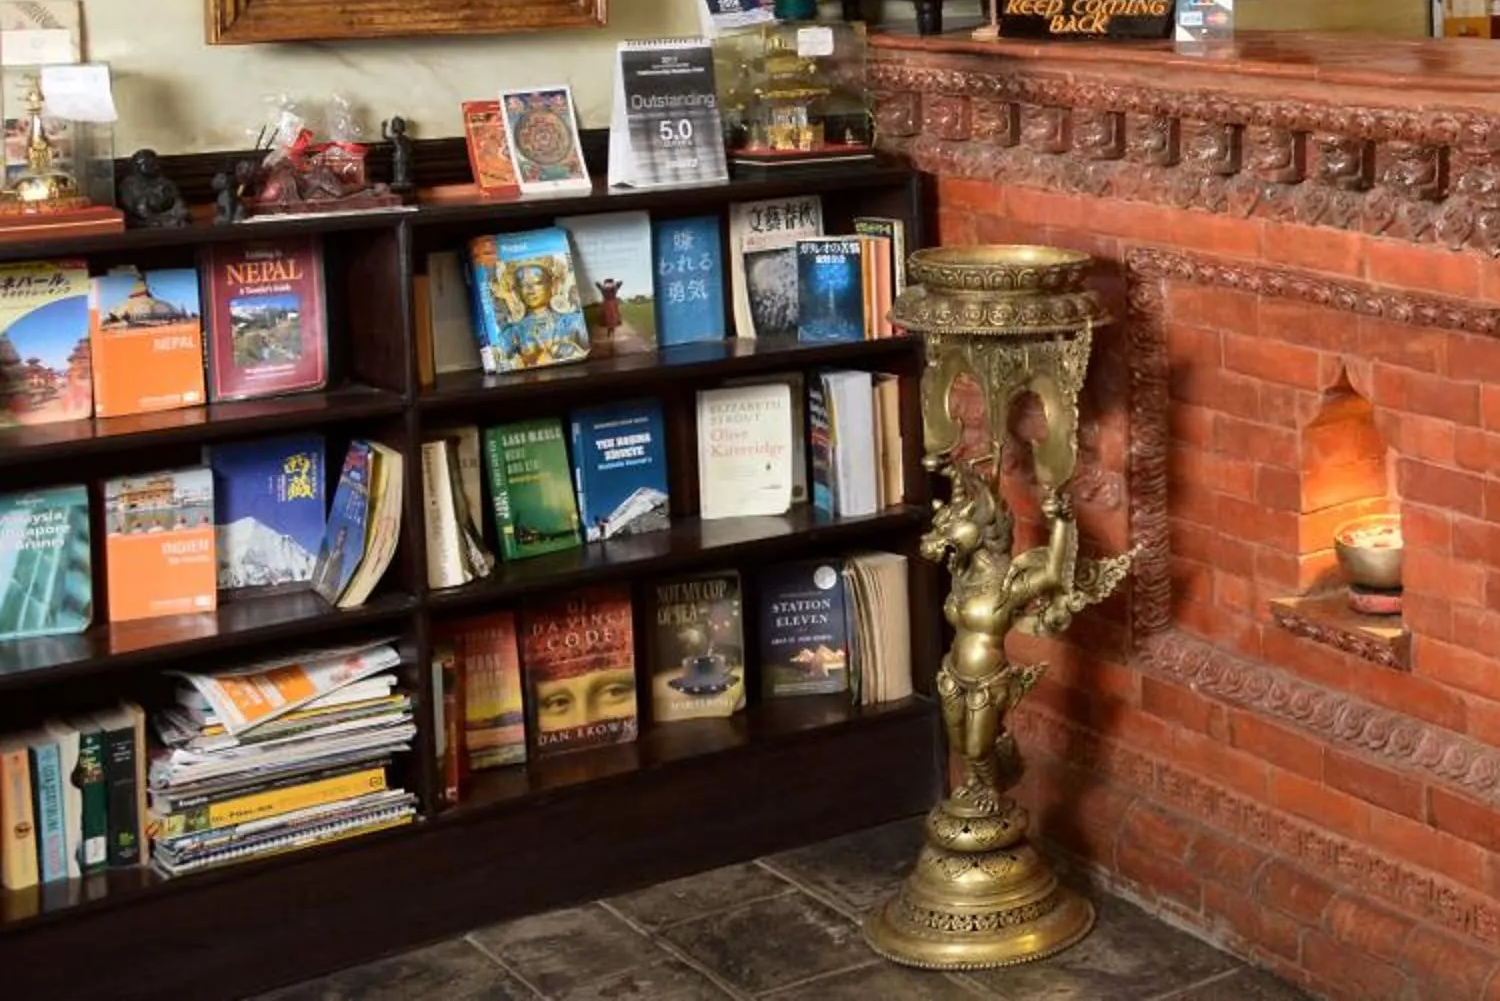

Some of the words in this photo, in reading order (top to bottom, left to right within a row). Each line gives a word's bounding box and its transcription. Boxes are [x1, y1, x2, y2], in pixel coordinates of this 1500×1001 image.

[1050, 12, 1110, 35] BACK
[631, 93, 716, 110] Outstanding
[660, 118, 693, 141] 5.0
[226, 258, 304, 286] NEPAL
[153, 336, 194, 350] NEPAL
[772, 598, 831, 614] STATION
[776, 615, 828, 628] ELEVEN
[547, 628, 614, 650] CODE
[538, 731, 570, 747] DAN
